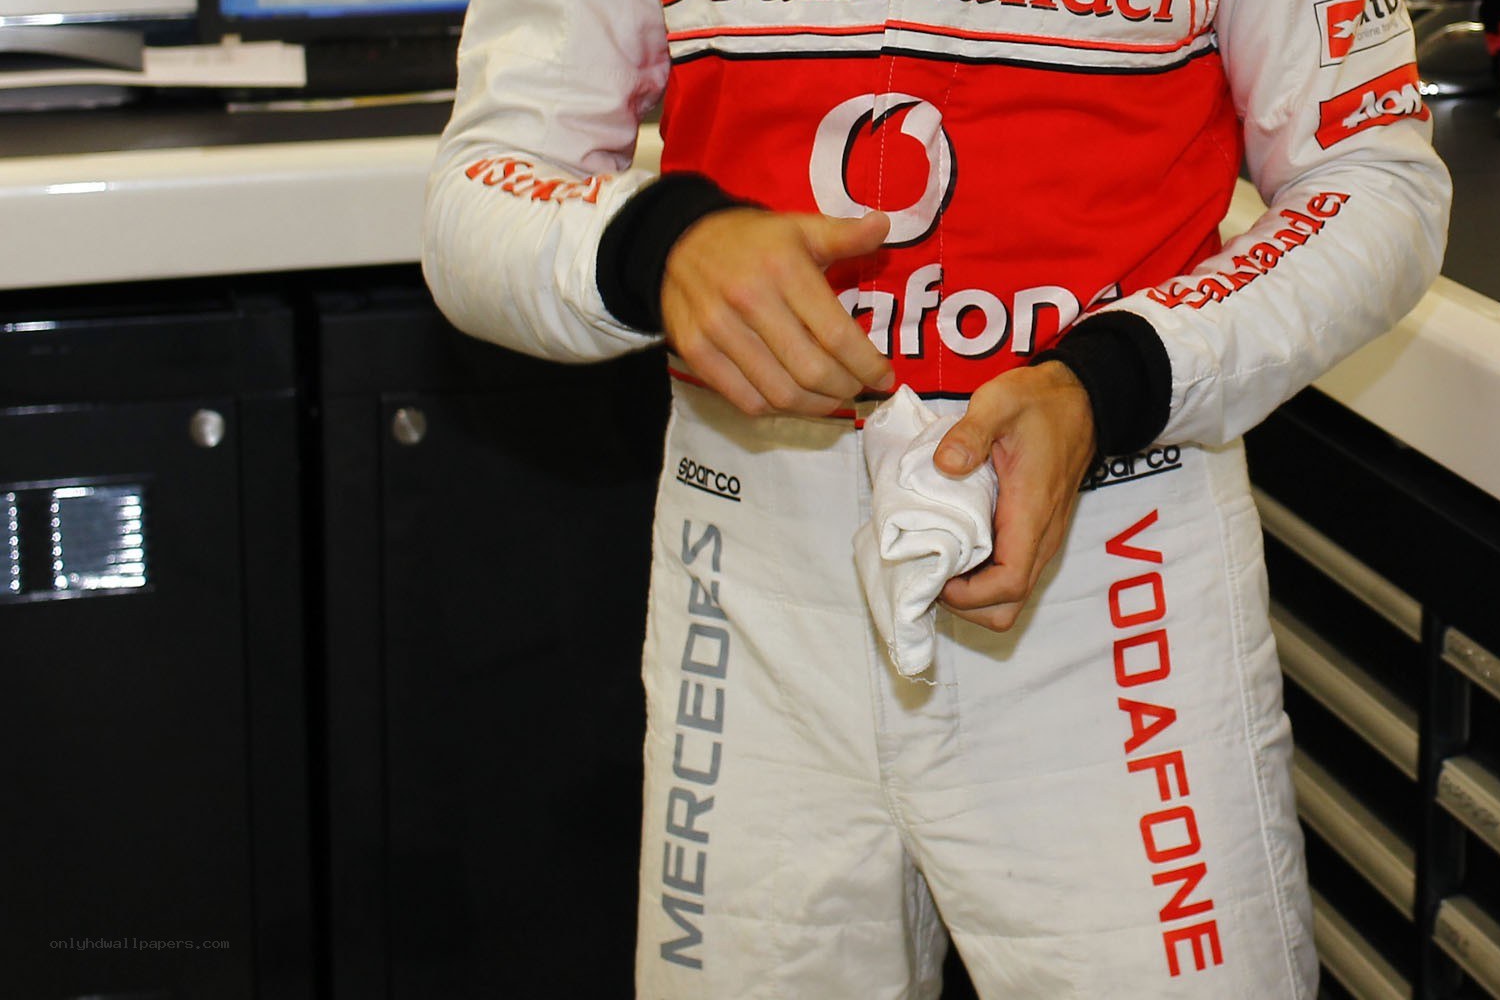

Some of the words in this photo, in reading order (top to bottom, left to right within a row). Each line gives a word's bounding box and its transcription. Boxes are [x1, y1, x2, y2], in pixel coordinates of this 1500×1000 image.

[677, 456, 741, 495] sparco
[1081, 445, 1181, 491] parco
[660, 518, 733, 971] MERCEDES
[1104, 507, 1225, 978] VODAFONE
